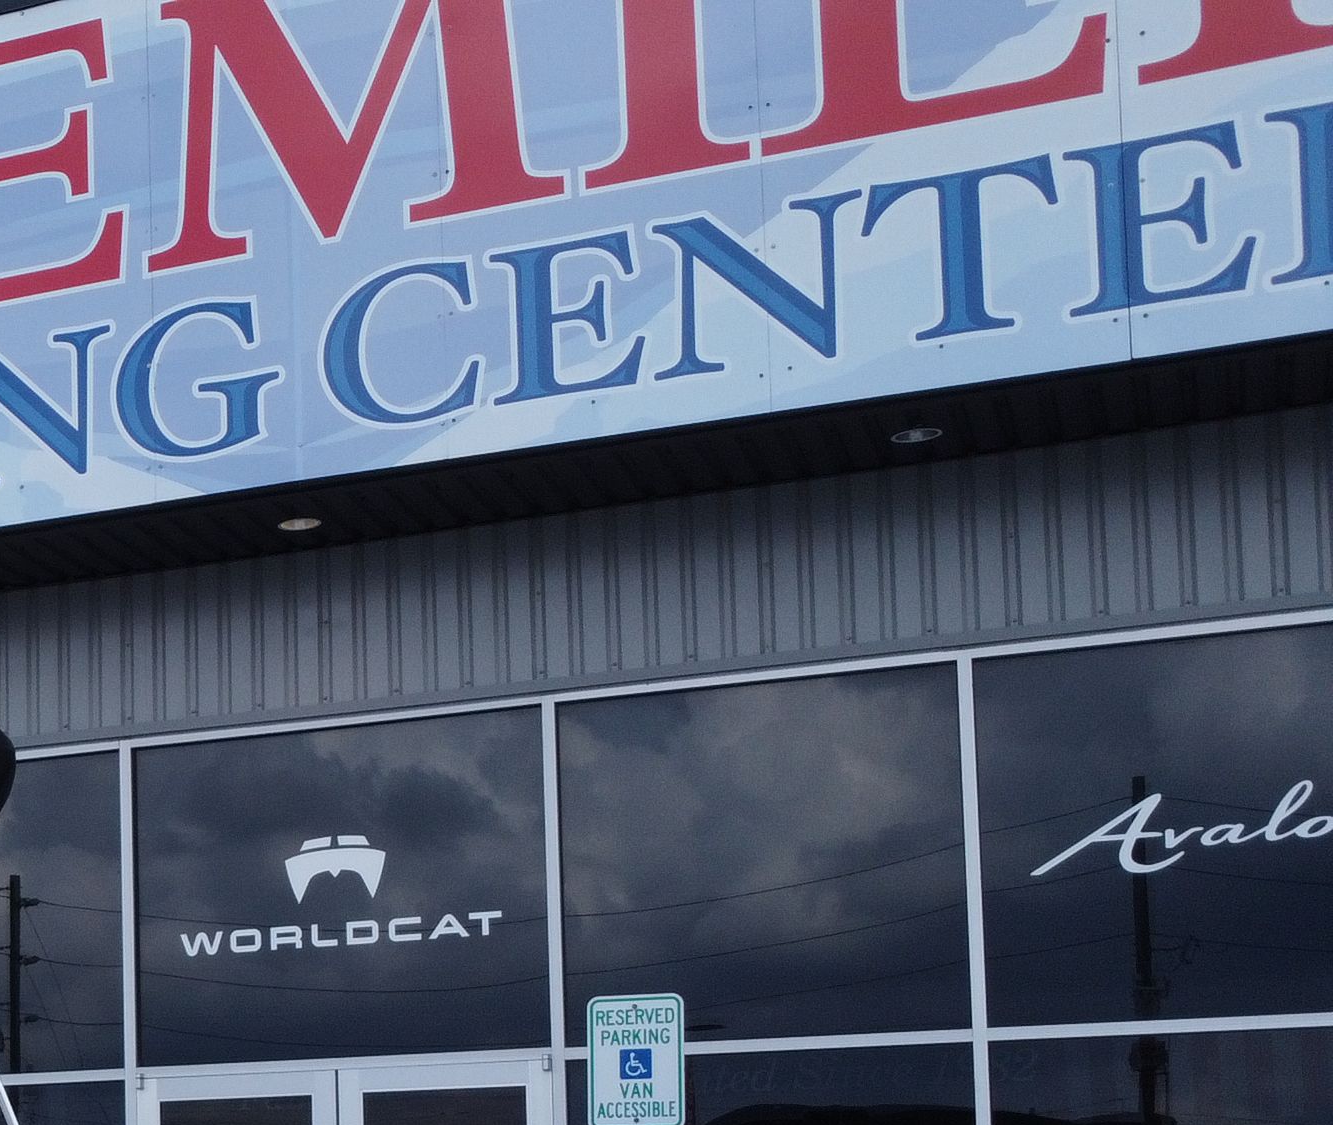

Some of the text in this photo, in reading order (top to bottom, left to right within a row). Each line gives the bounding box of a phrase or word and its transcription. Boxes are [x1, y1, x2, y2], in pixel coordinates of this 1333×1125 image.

[179, 910, 503, 957] WORLDCAT
[595, 1006, 675, 1026] RESERVED
[600, 1028, 671, 1046] PARKING
[619, 1082, 653, 1099] VAN
[596, 1101, 677, 1119] ACCESSIBLE
